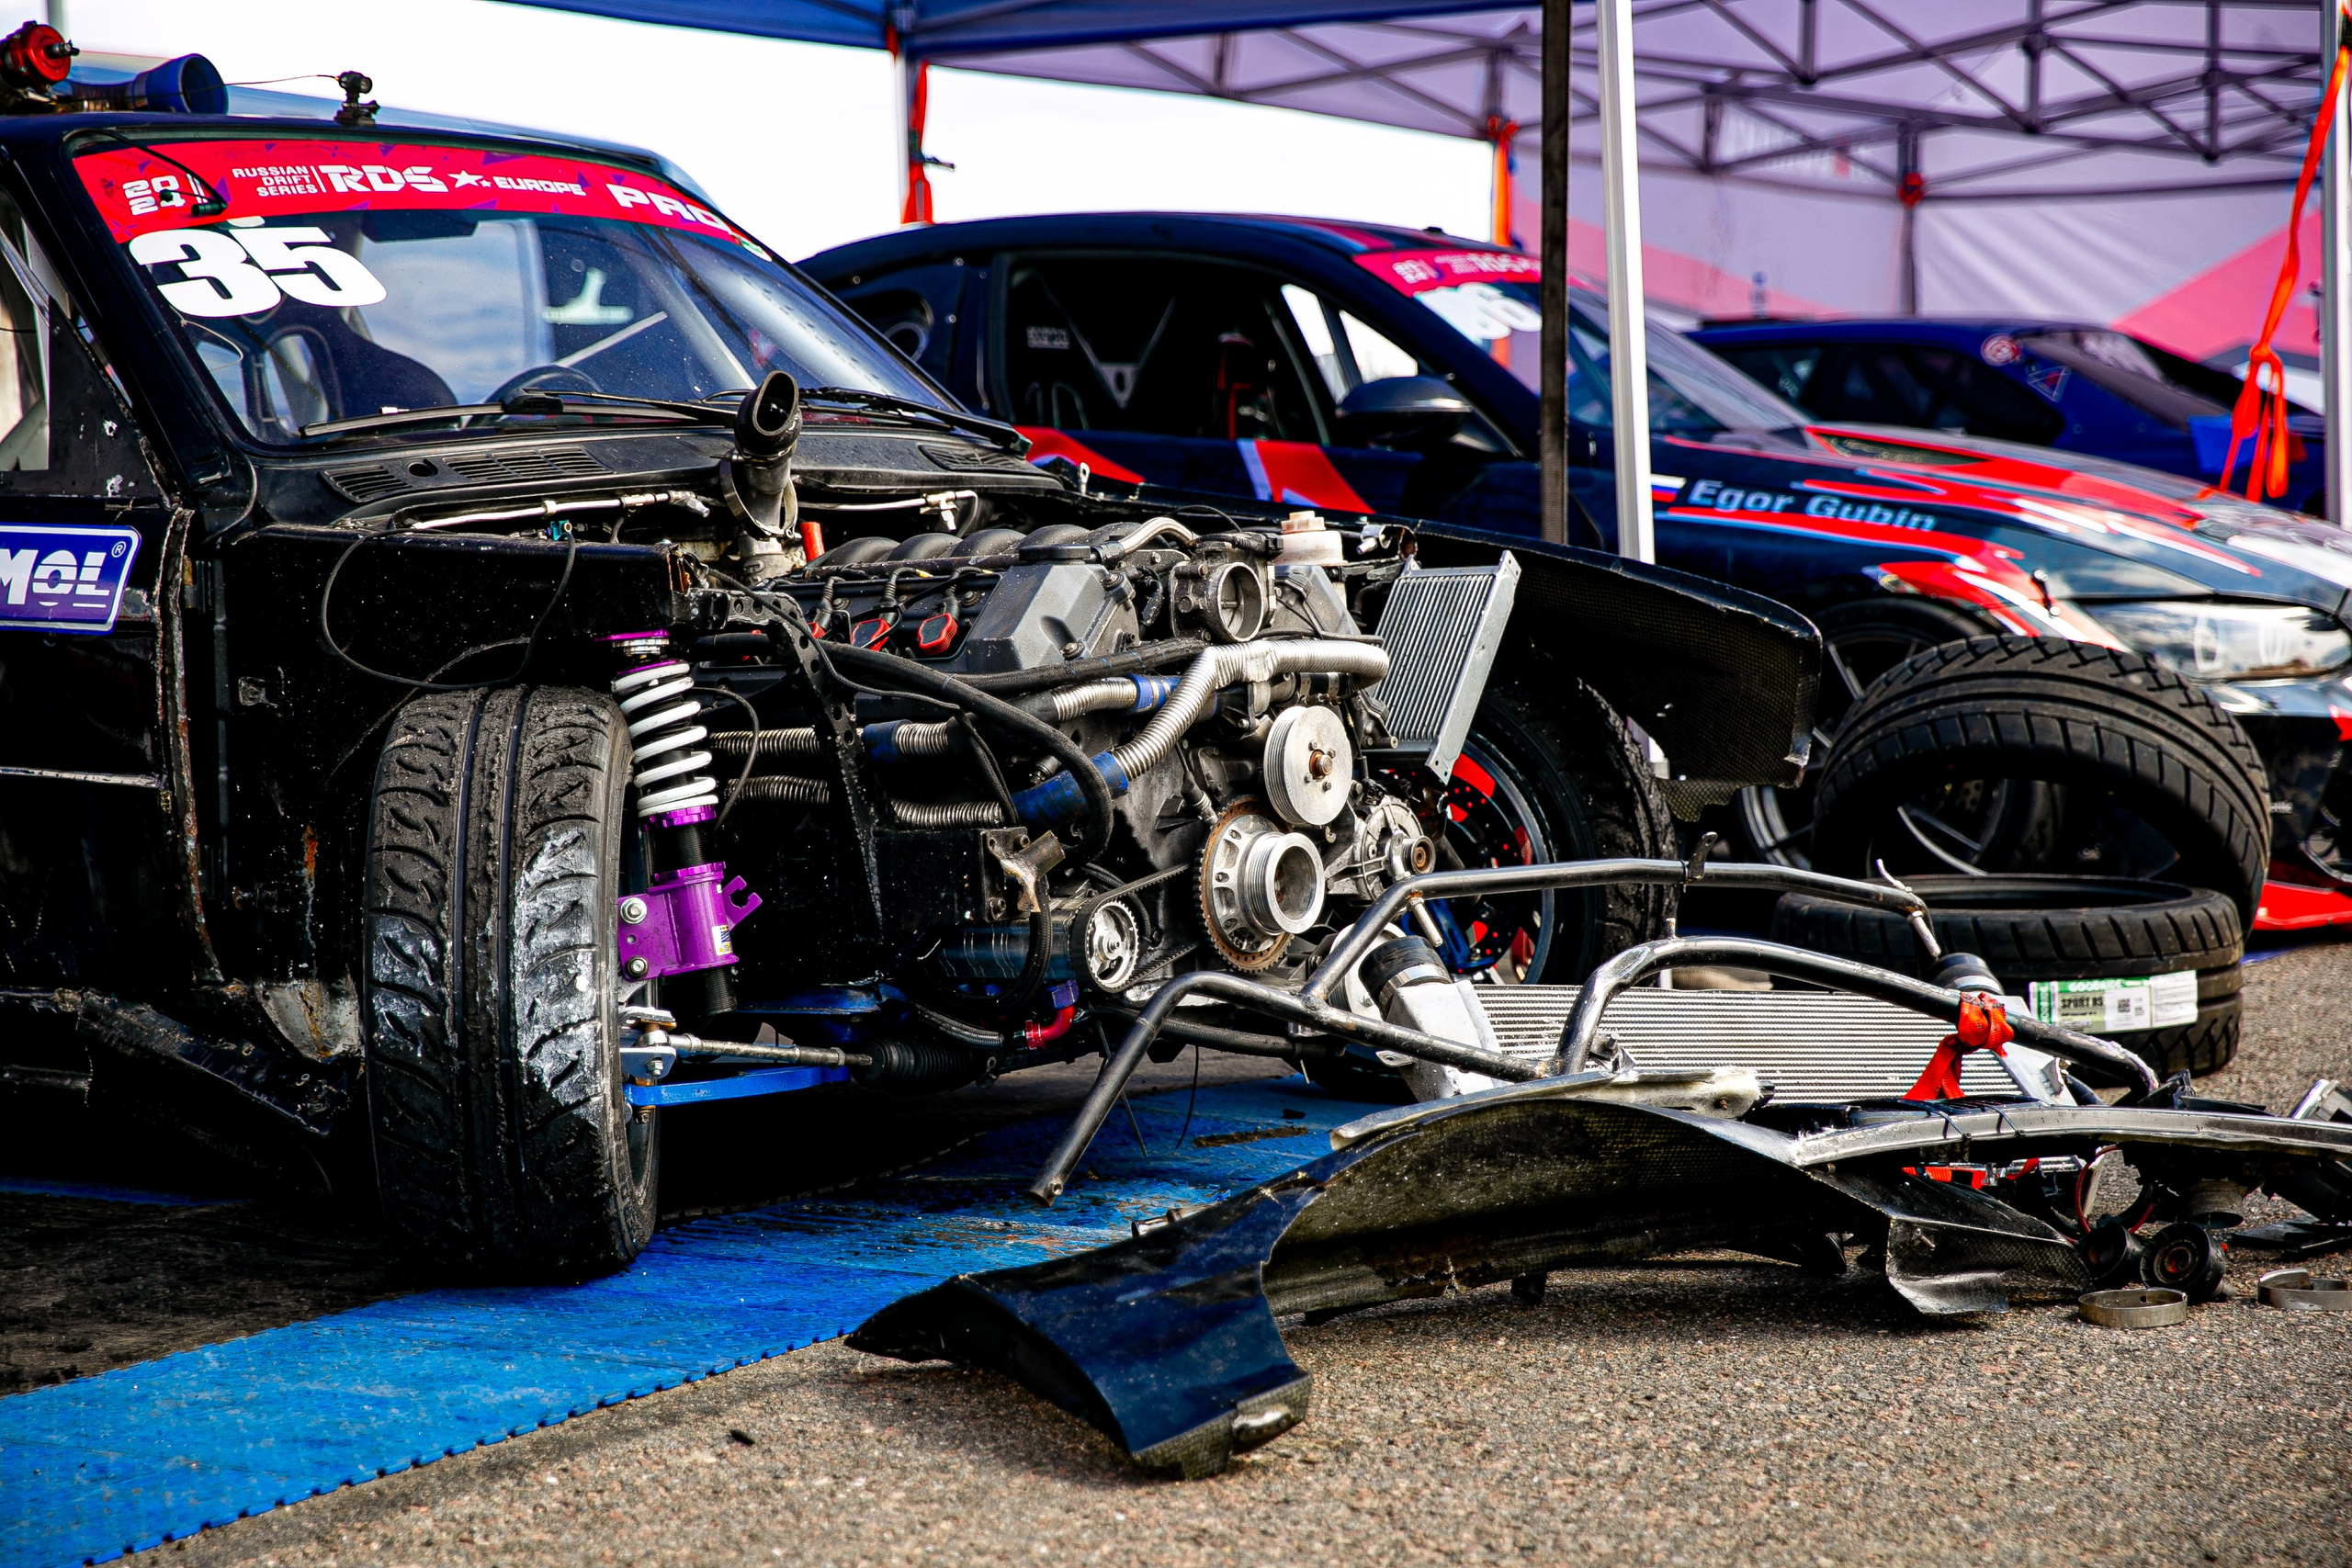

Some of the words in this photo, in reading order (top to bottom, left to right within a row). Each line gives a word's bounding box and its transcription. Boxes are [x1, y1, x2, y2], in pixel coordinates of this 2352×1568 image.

[232, 165, 309, 178] RUSSIAN
[262, 175, 311, 186] DRIFT
[256, 184, 318, 197] SERIES
[321, 164, 447, 192] RDS
[492, 175, 586, 196] EUROPE
[606, 184, 734, 236] PRO
[129, 227, 387, 317] 35
[1688, 479, 1793, 513] Egor
[1804, 494, 1938, 532] Gubin
